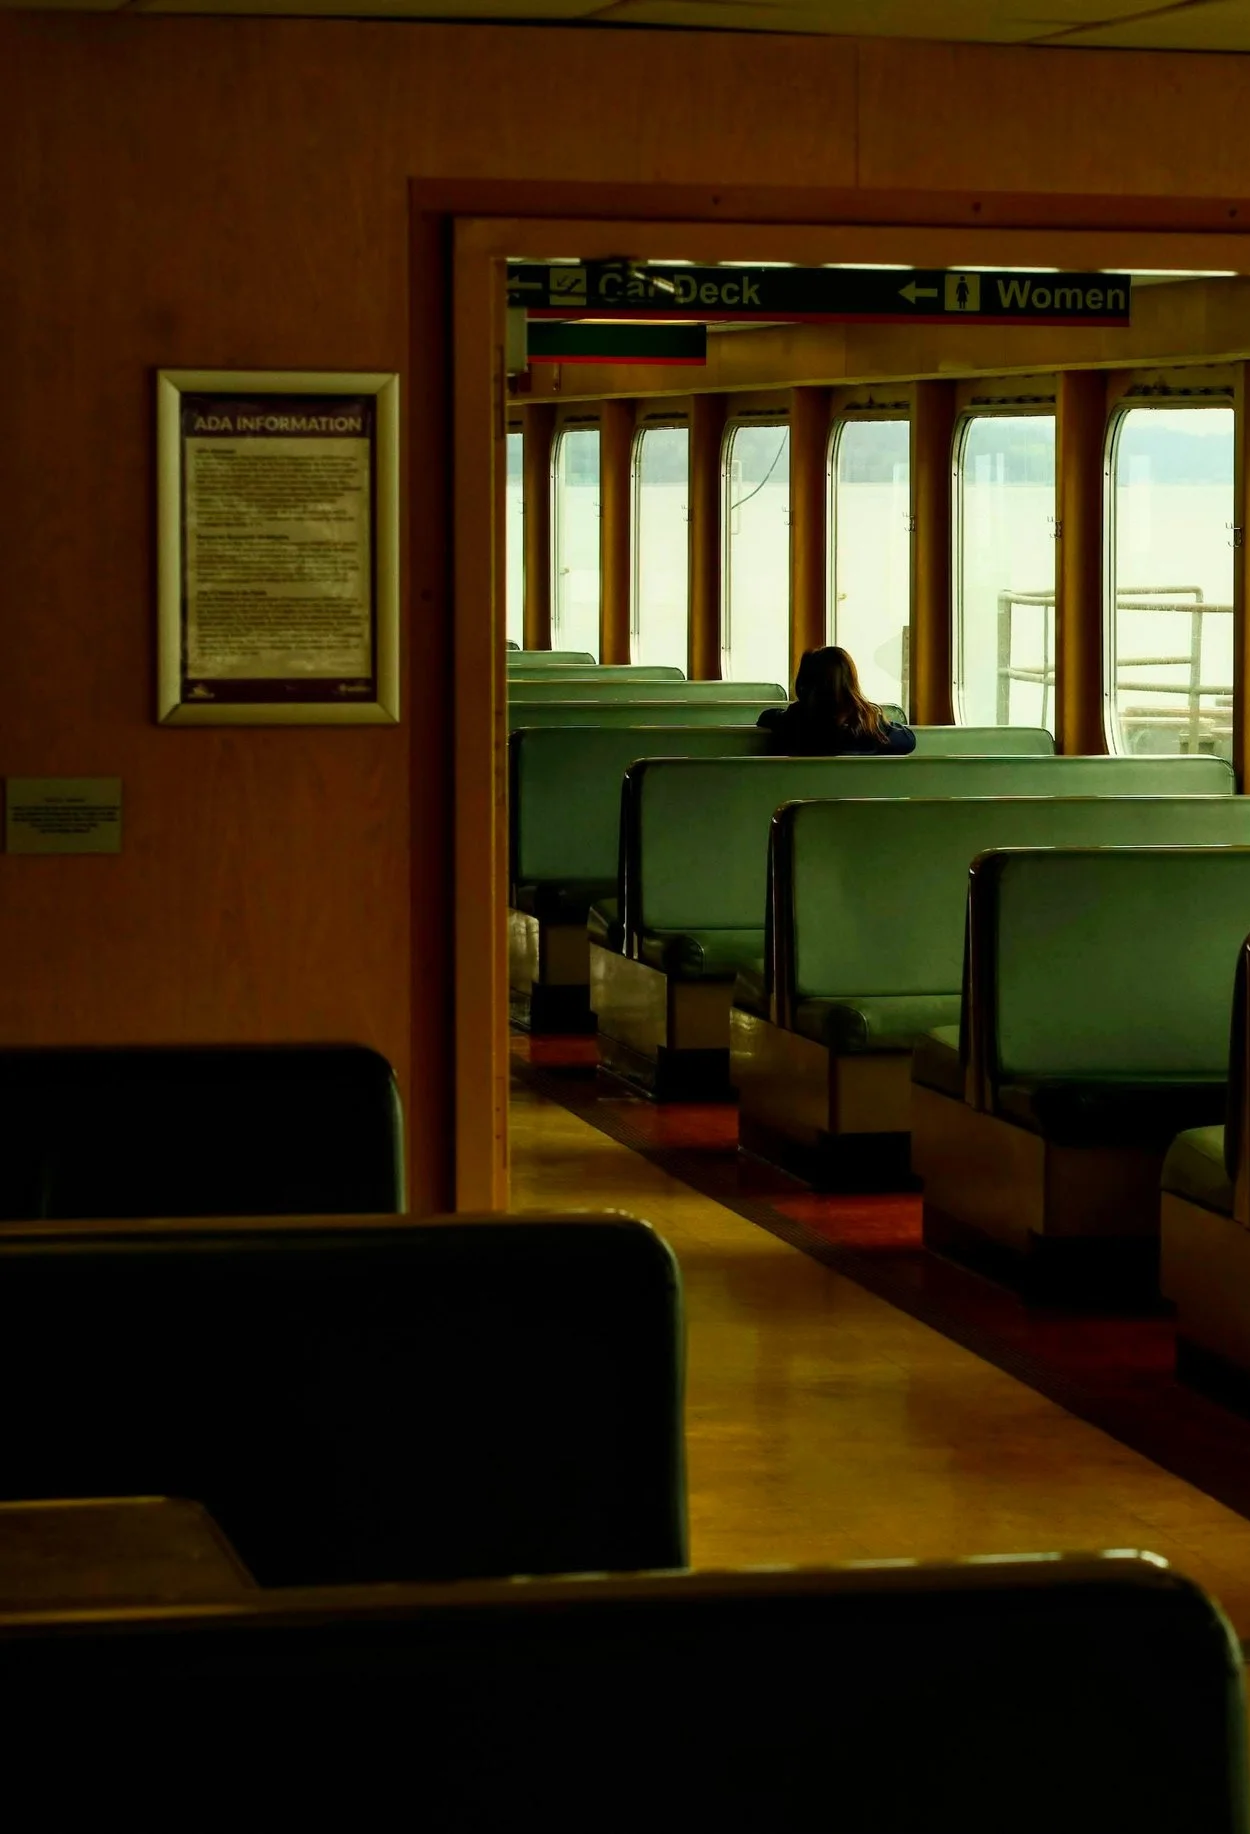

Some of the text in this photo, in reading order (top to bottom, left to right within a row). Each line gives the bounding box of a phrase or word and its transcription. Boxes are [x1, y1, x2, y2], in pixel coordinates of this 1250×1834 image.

[674, 274, 761, 305] Deck
[997, 279, 1126, 311] Women
[194, 416, 363, 432] ADA INFORMATION
